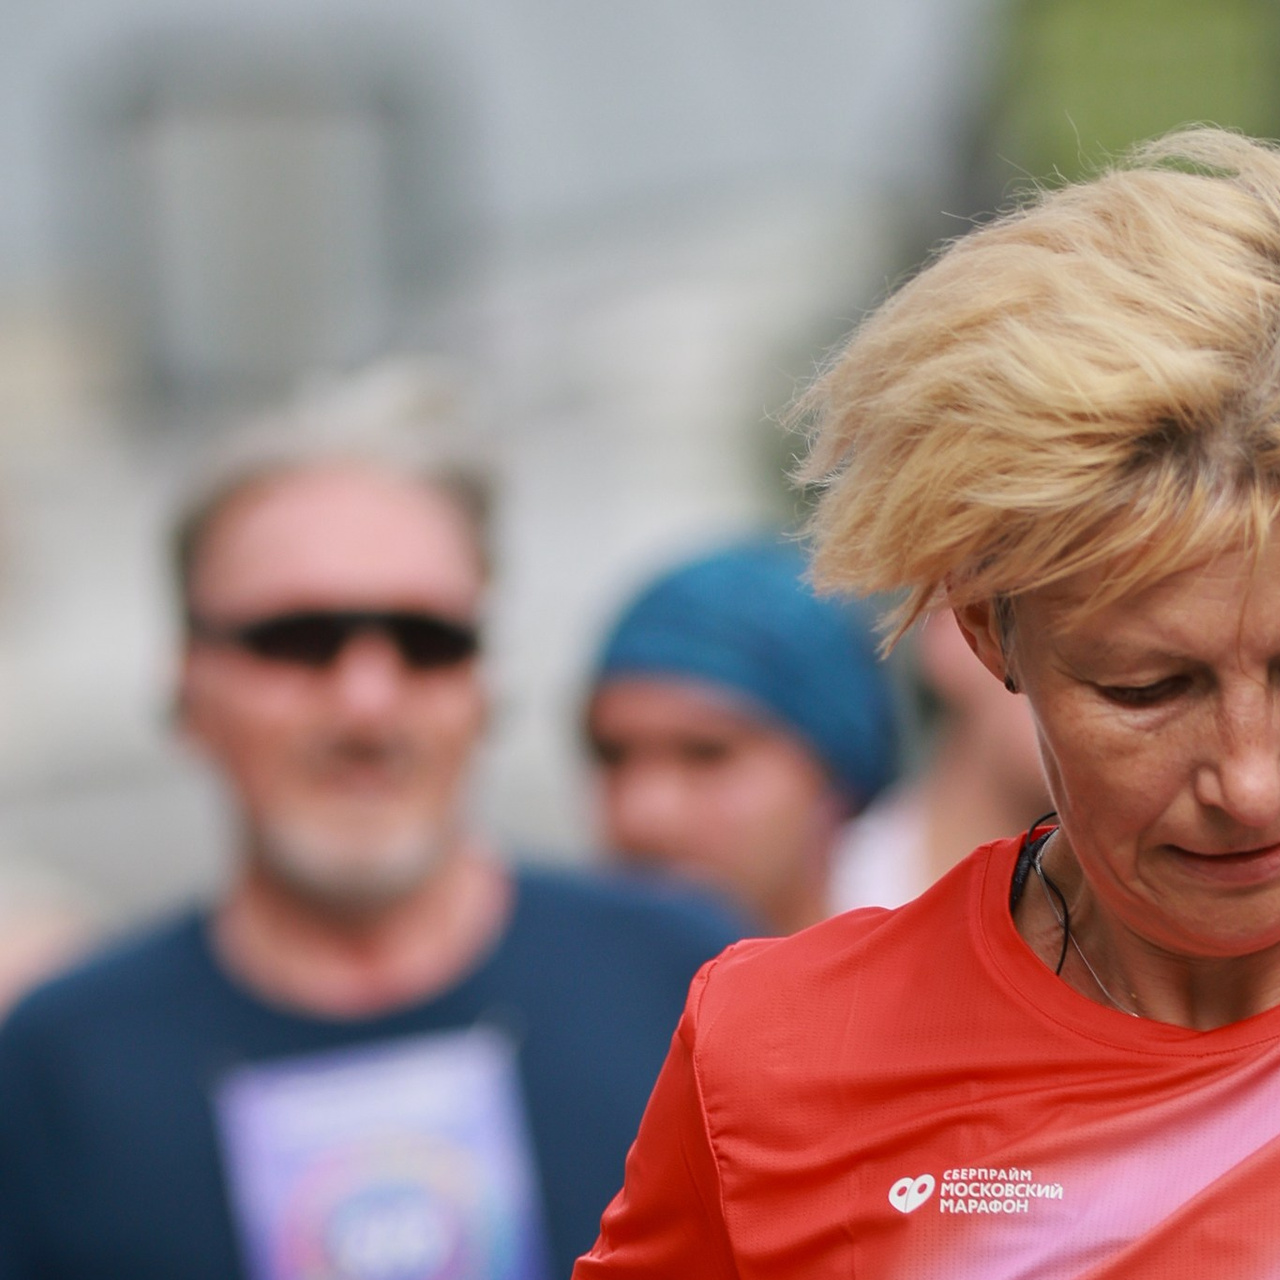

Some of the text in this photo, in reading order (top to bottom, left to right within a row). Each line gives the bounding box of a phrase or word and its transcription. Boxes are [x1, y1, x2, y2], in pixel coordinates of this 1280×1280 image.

[943, 1167, 1032, 1181] СБЕРПРАЙМ
[940, 1182, 1063, 1200] МОСКОВСКИЙ
[940, 1199, 1028, 1214] МАРАФОН
